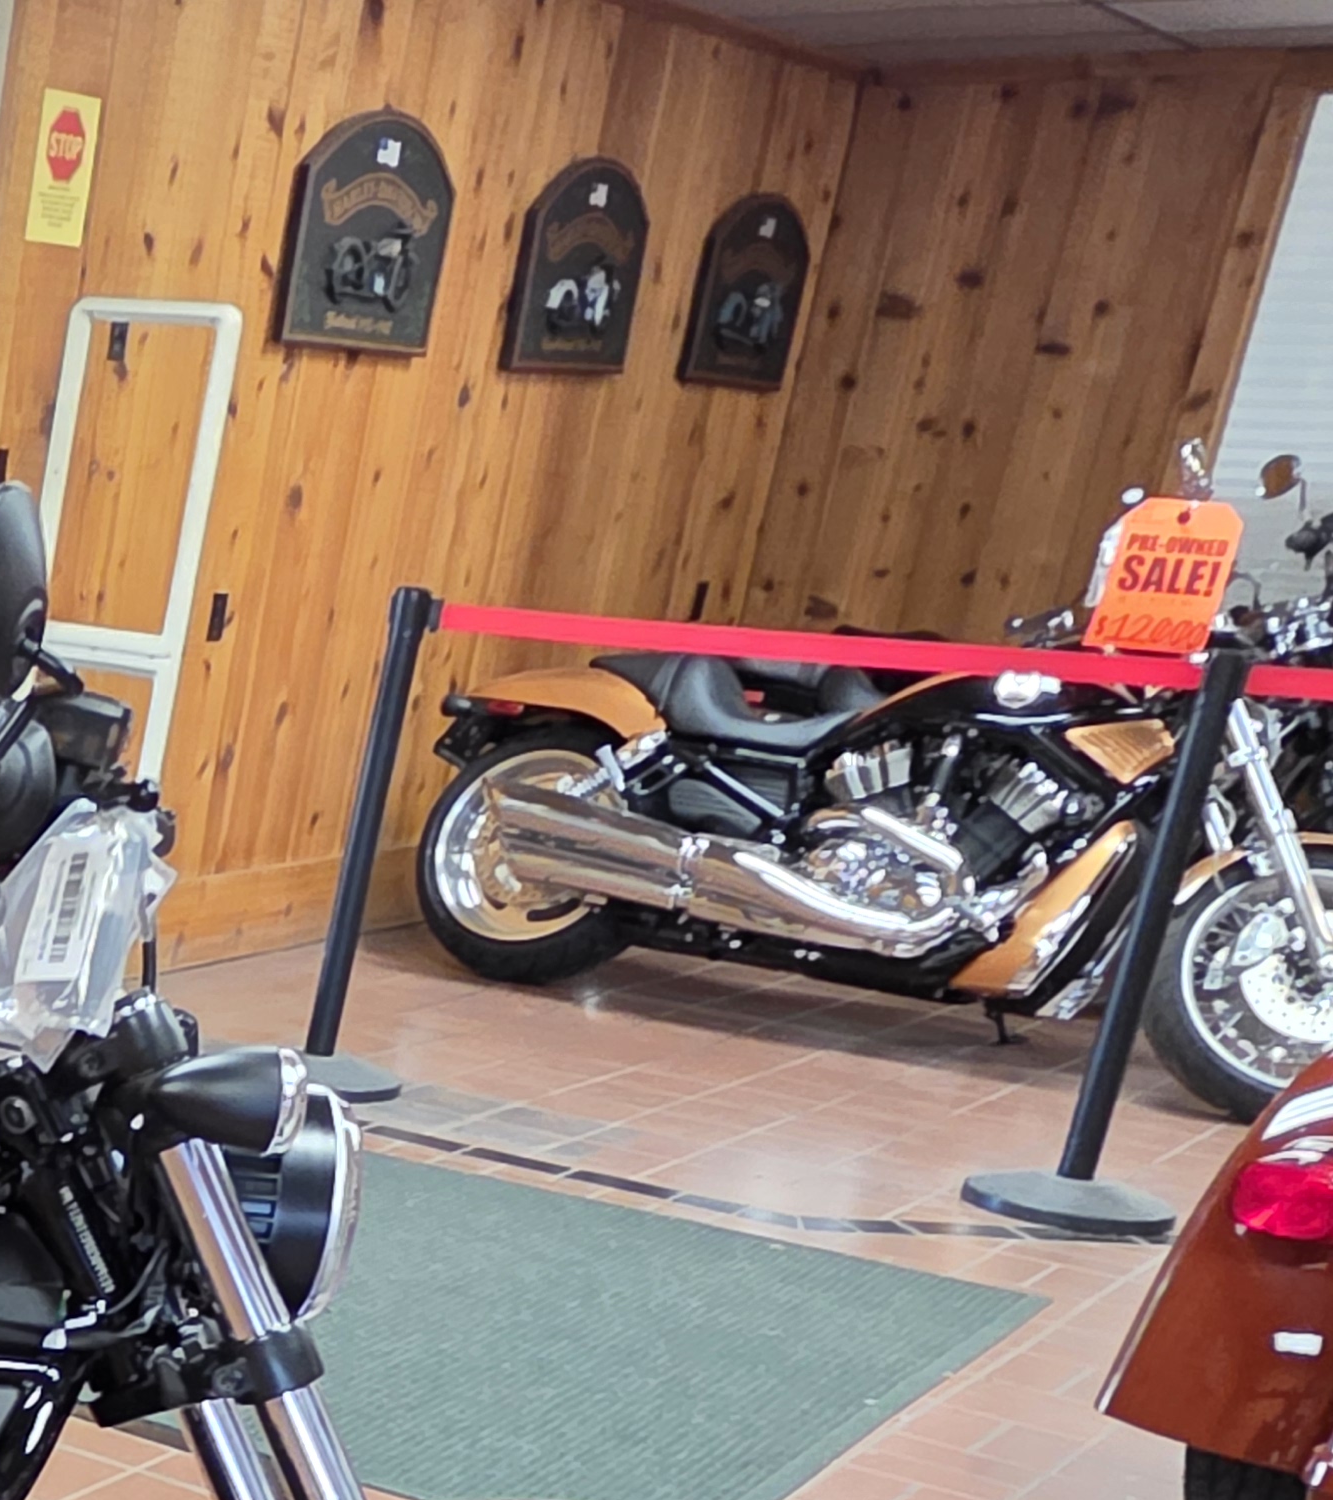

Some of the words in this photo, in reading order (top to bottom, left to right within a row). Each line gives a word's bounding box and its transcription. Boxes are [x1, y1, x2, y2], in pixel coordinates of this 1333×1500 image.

[49, 131, 83, 160] STOP
[1126, 533, 1229, 557] PRE-OWNED
[1118, 554, 1221, 597] SALE!
